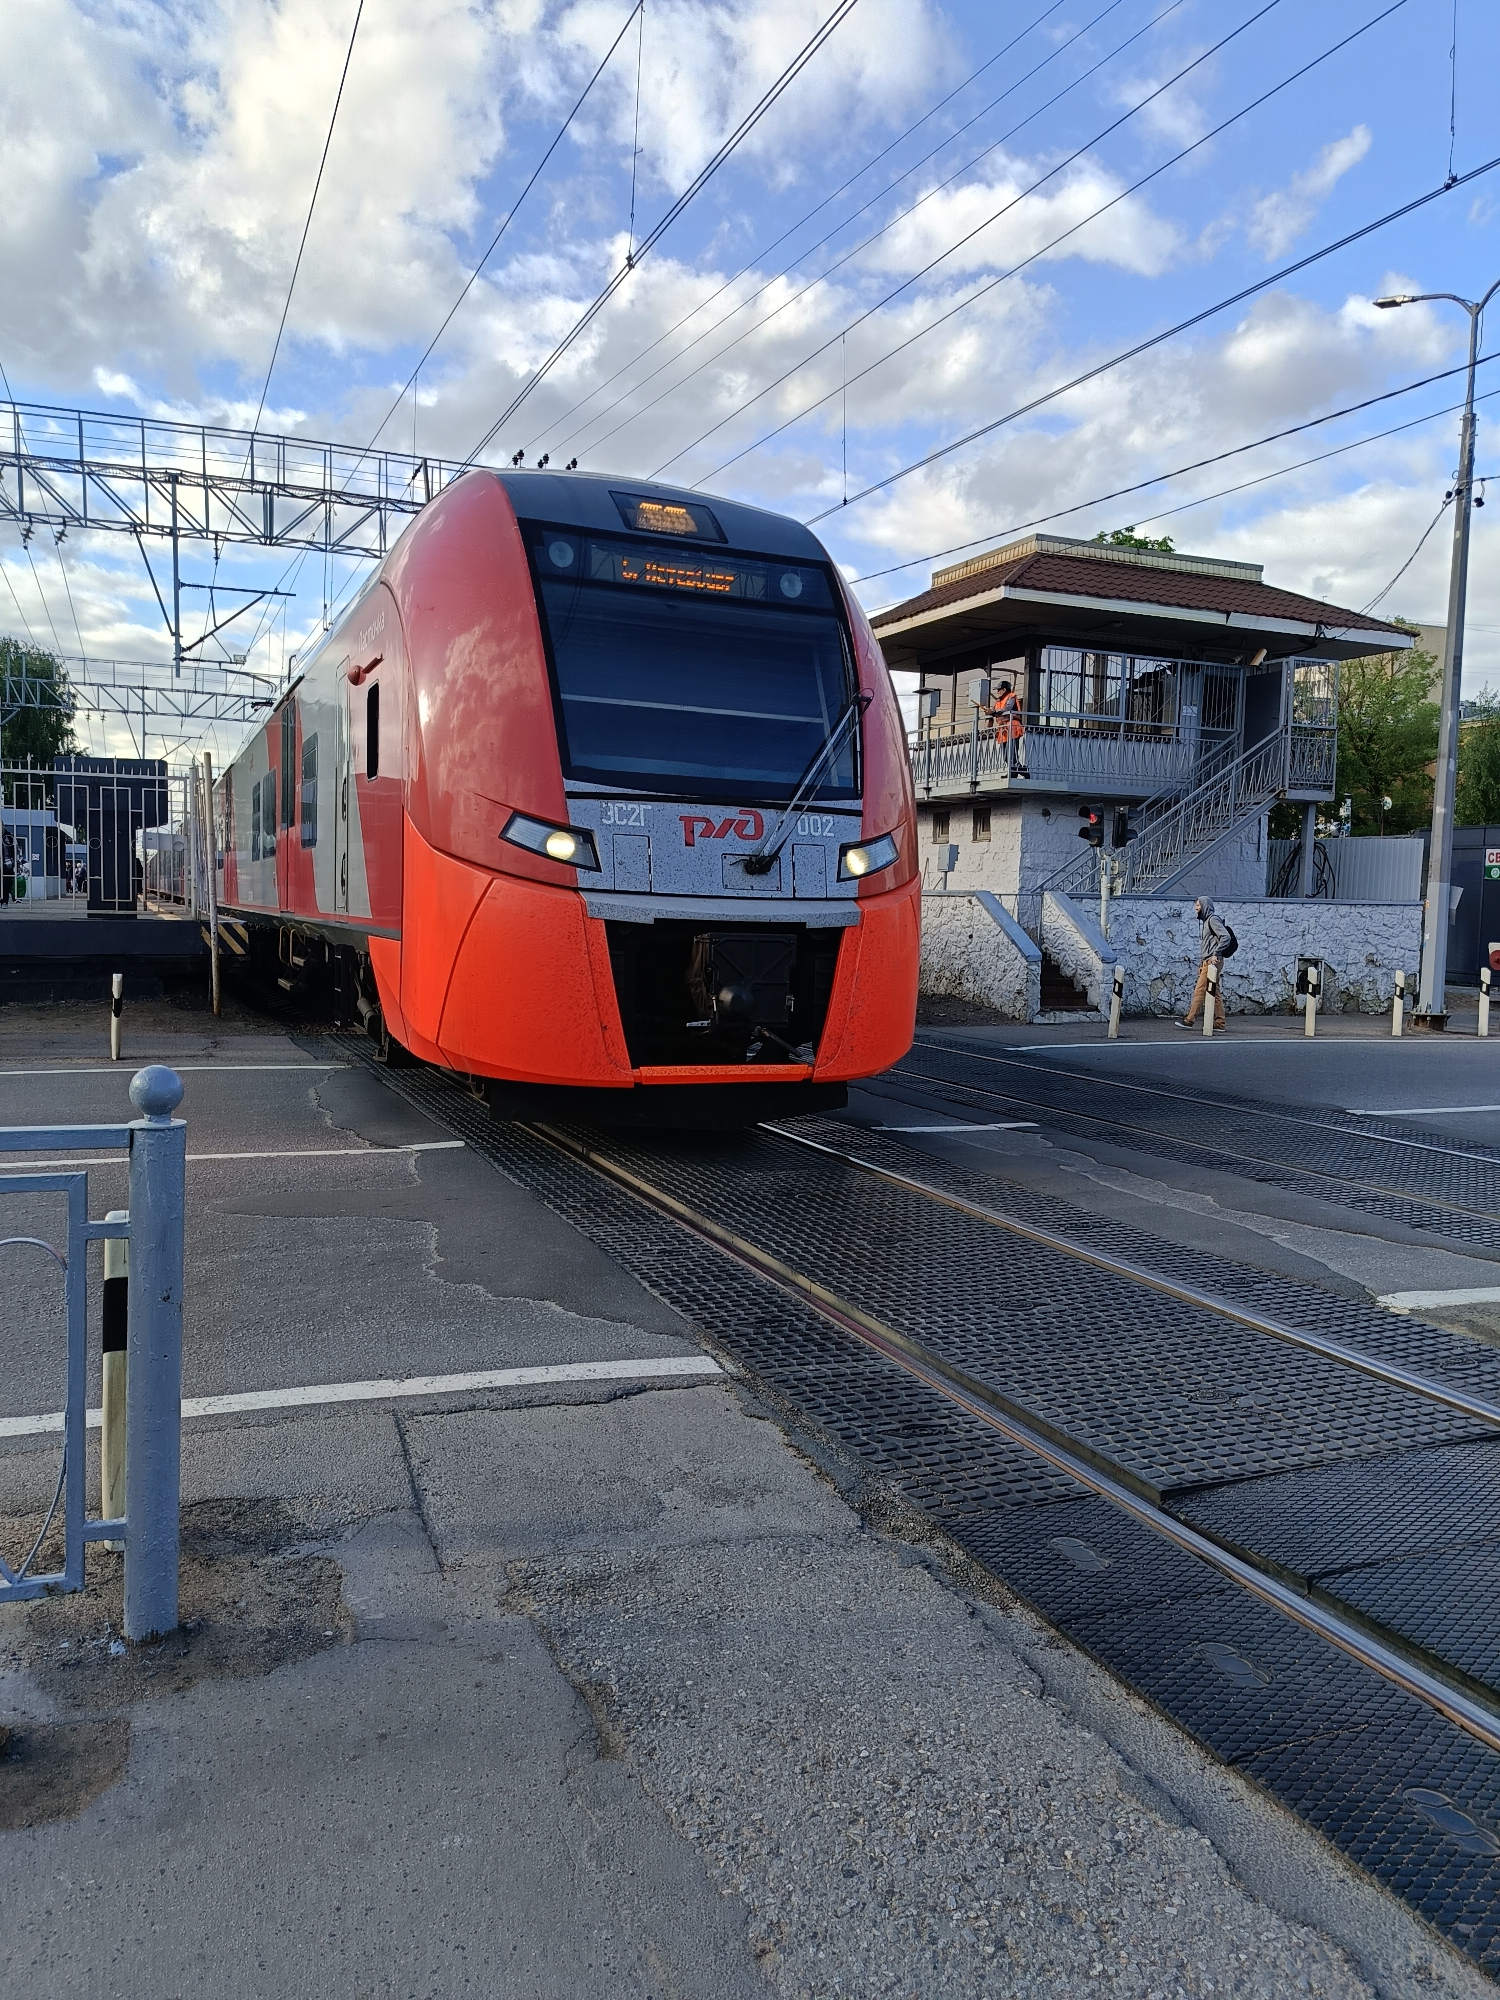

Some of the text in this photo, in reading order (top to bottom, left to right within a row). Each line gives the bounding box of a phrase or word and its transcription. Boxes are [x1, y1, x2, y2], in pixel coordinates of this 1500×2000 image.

[602, 801, 652, 828] ЭС2Г
[678, 809, 765, 847] РЖД
[796, 815, 835, 838] 002
